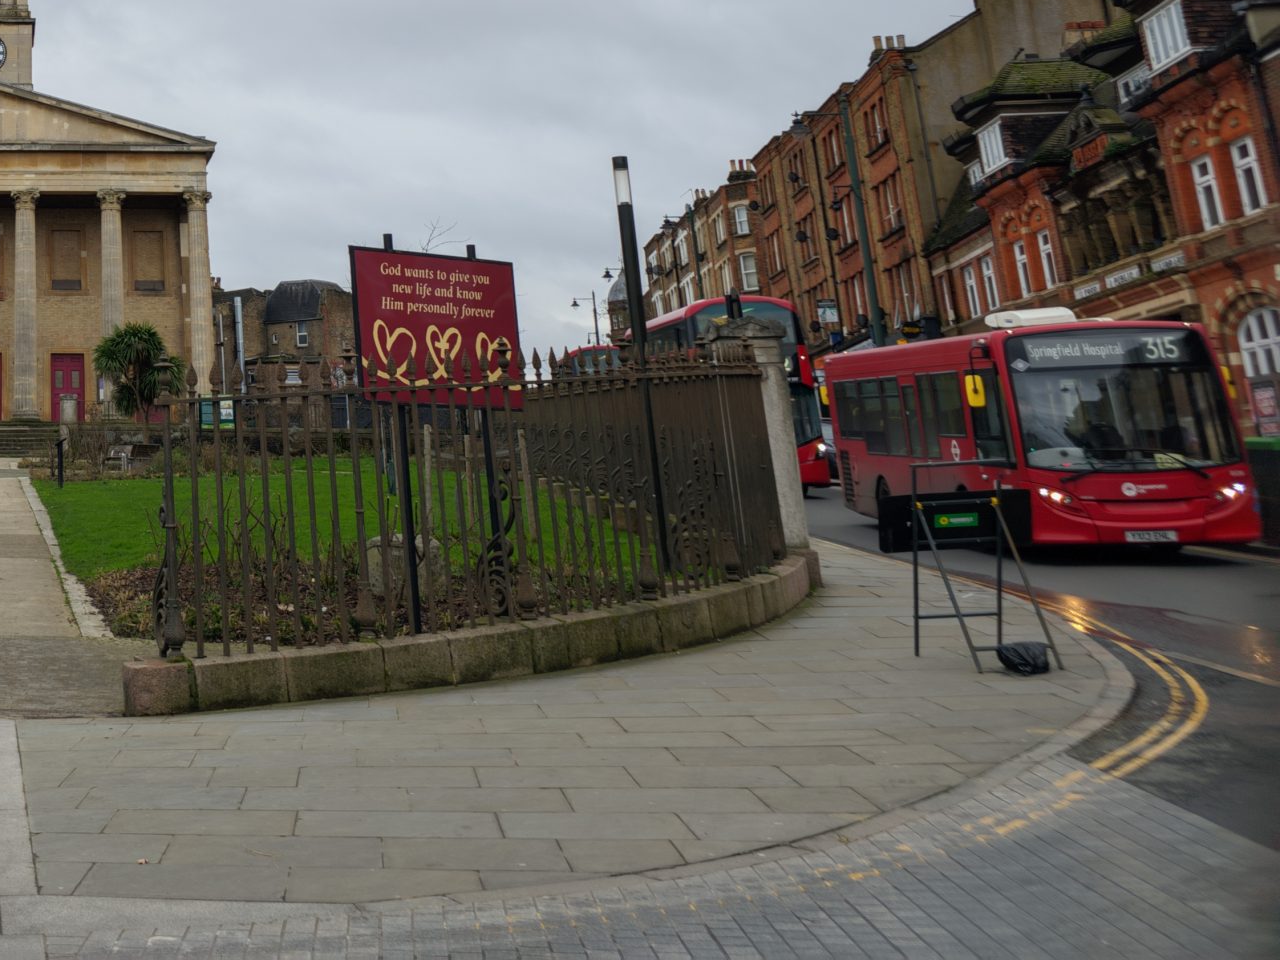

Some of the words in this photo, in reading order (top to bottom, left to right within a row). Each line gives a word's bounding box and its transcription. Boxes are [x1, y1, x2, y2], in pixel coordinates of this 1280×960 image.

[380, 262, 401, 277] God
[404, 267, 434, 279] wants
[437, 269, 447, 281] to
[449, 270, 470, 284] give
[472, 274, 490, 287] you
[392, 283, 413, 294] new
[415, 282, 432, 299] life
[434, 285, 454, 298] and
[456, 287, 482, 301] know
[381, 297, 404, 311] Him
[407, 301, 459, 319] personally
[461, 304, 495, 319] forever
[1028, 342, 1081, 360] Springfield
[1082, 341, 1126, 359] Hospital
[1141, 336, 1180, 359] 315
